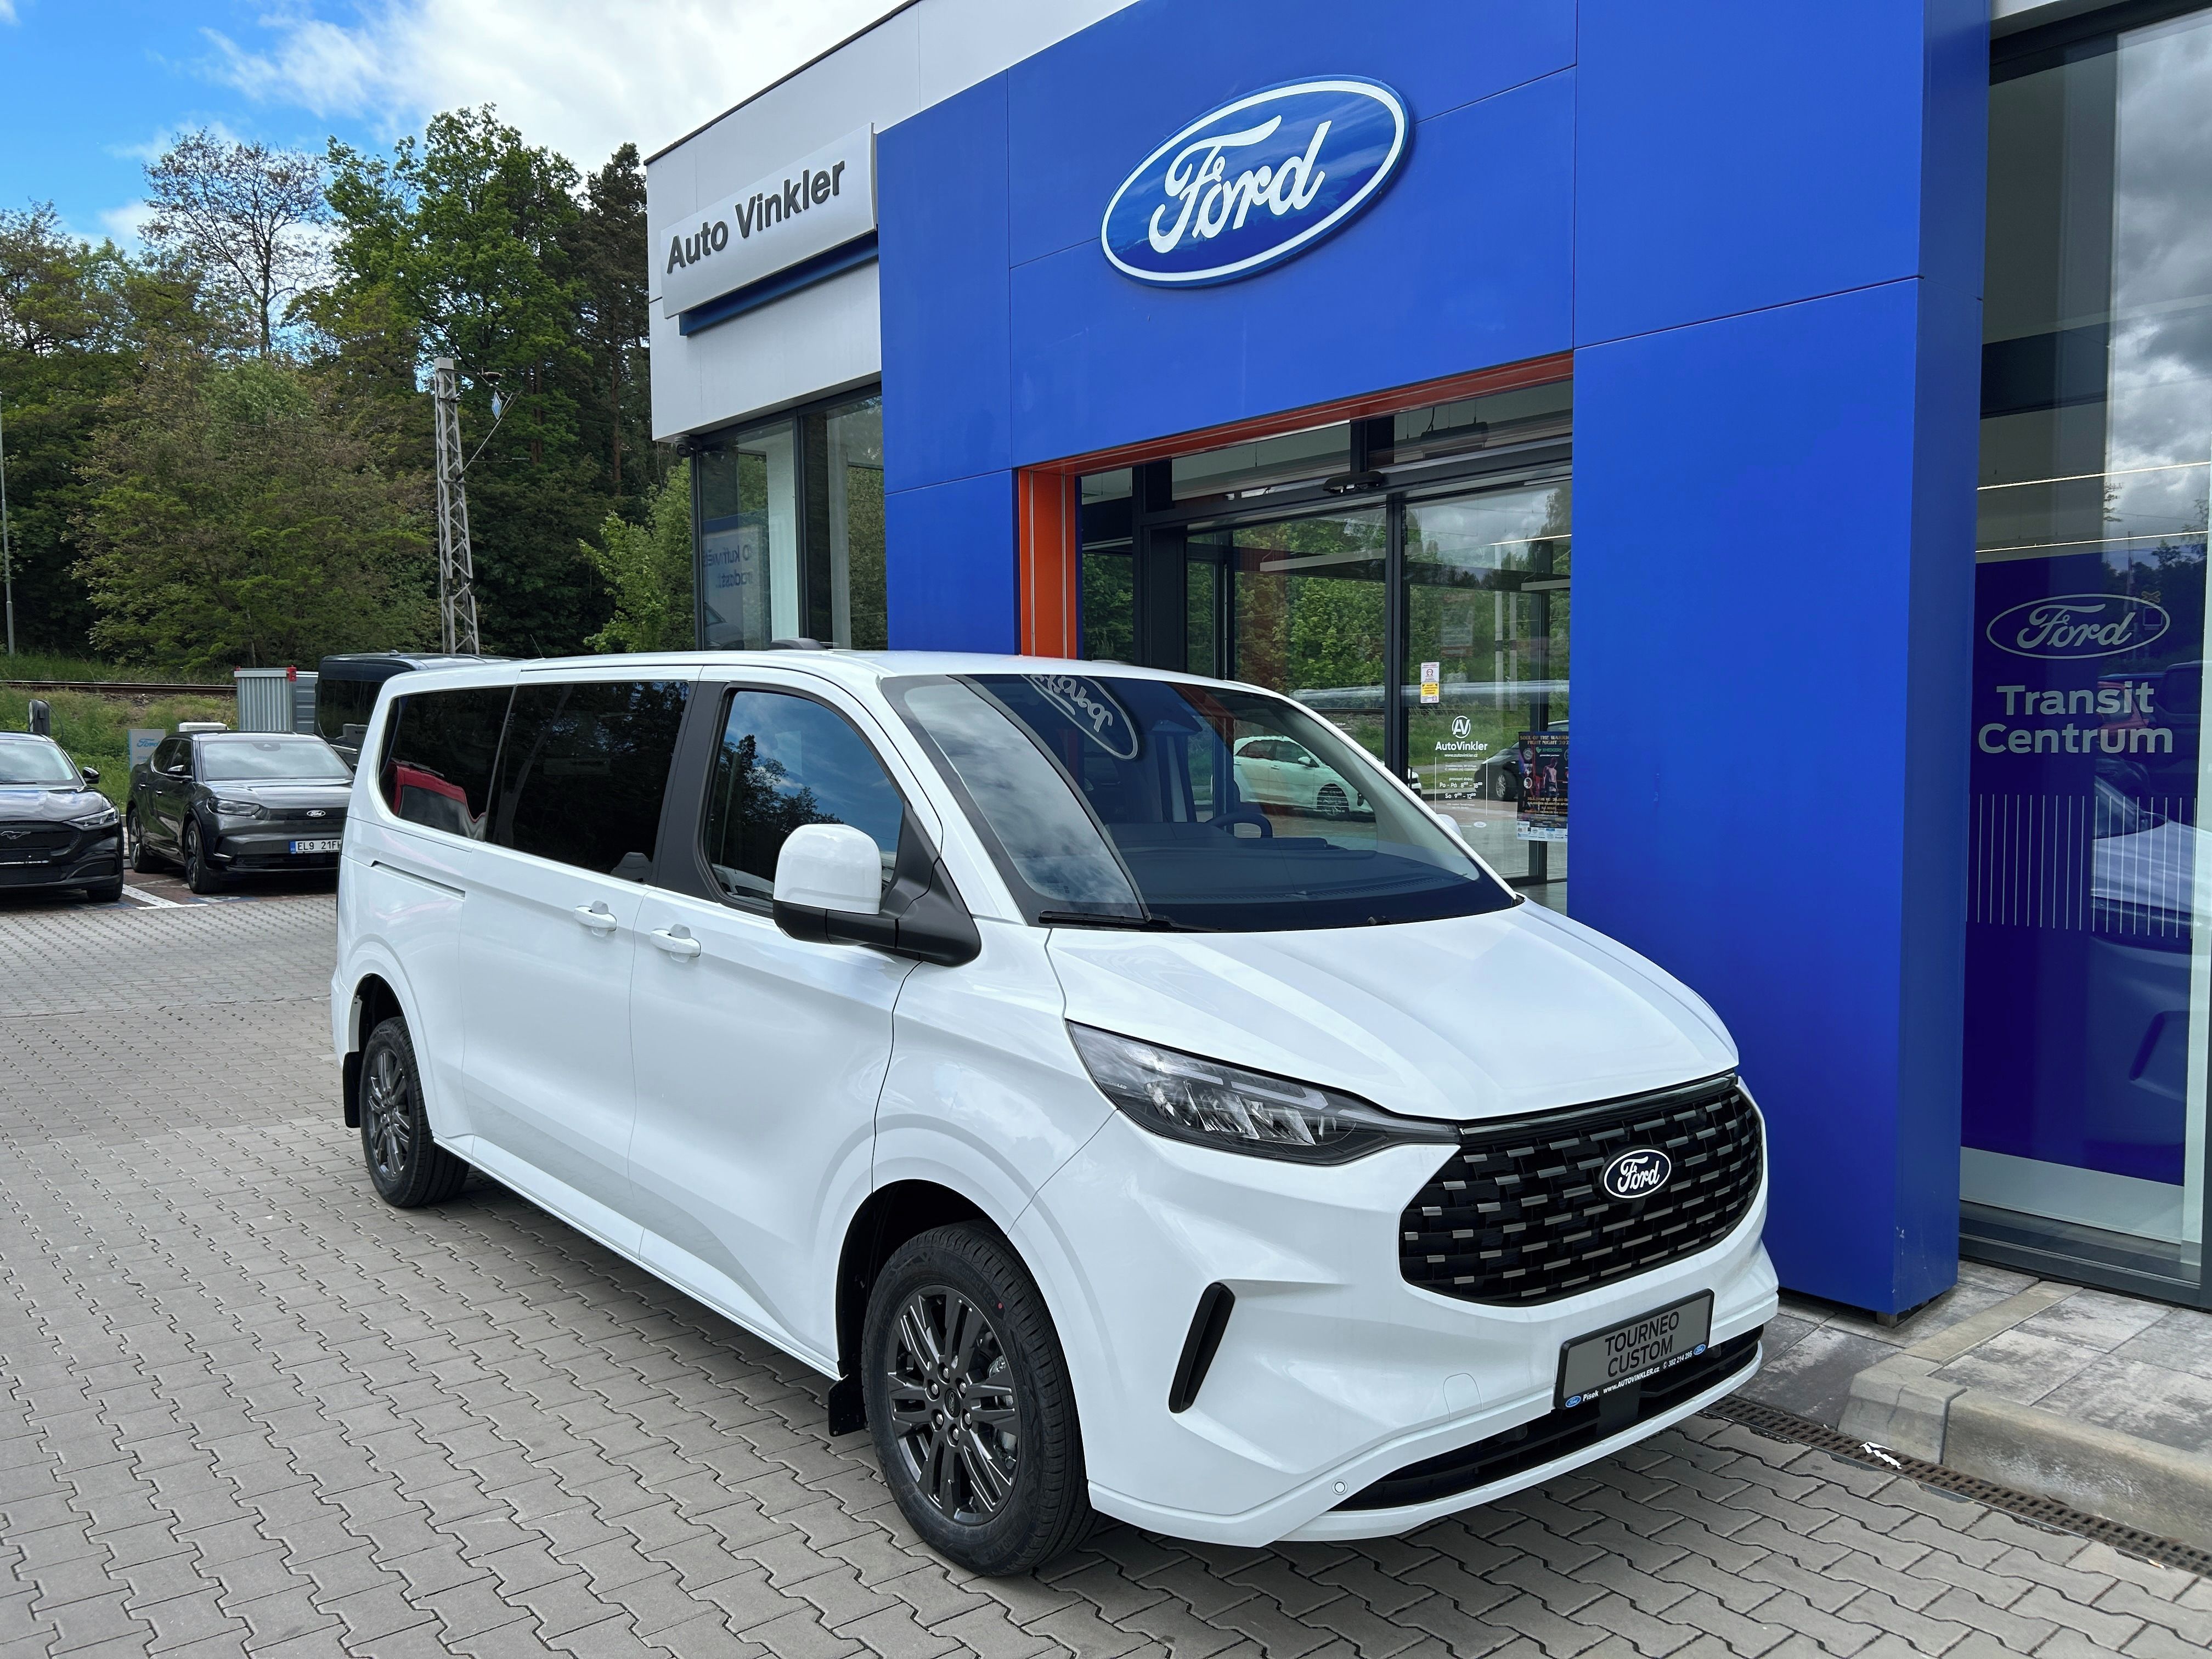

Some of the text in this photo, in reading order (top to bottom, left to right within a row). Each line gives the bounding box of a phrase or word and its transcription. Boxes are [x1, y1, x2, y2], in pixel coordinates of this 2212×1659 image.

[1148, 115, 1332, 253] Ford
[667, 160, 845, 274] Auto Vinkler
[2017, 603, 2136, 649] Ford
[1996, 681, 2154, 715] Transit
[137, 738, 160, 747] Ford
[1453, 719, 1470, 735] AV
[1978, 723, 2173, 754] Centrum
[1435, 741, 1488, 751] AutoVinkler
[297, 842, 314, 850] EL9
[1617, 1156, 1660, 1193] Ford
[1605, 1311, 1679, 1356] TOURNEO
[1607, 1334, 1673, 1377] CUSTOM
